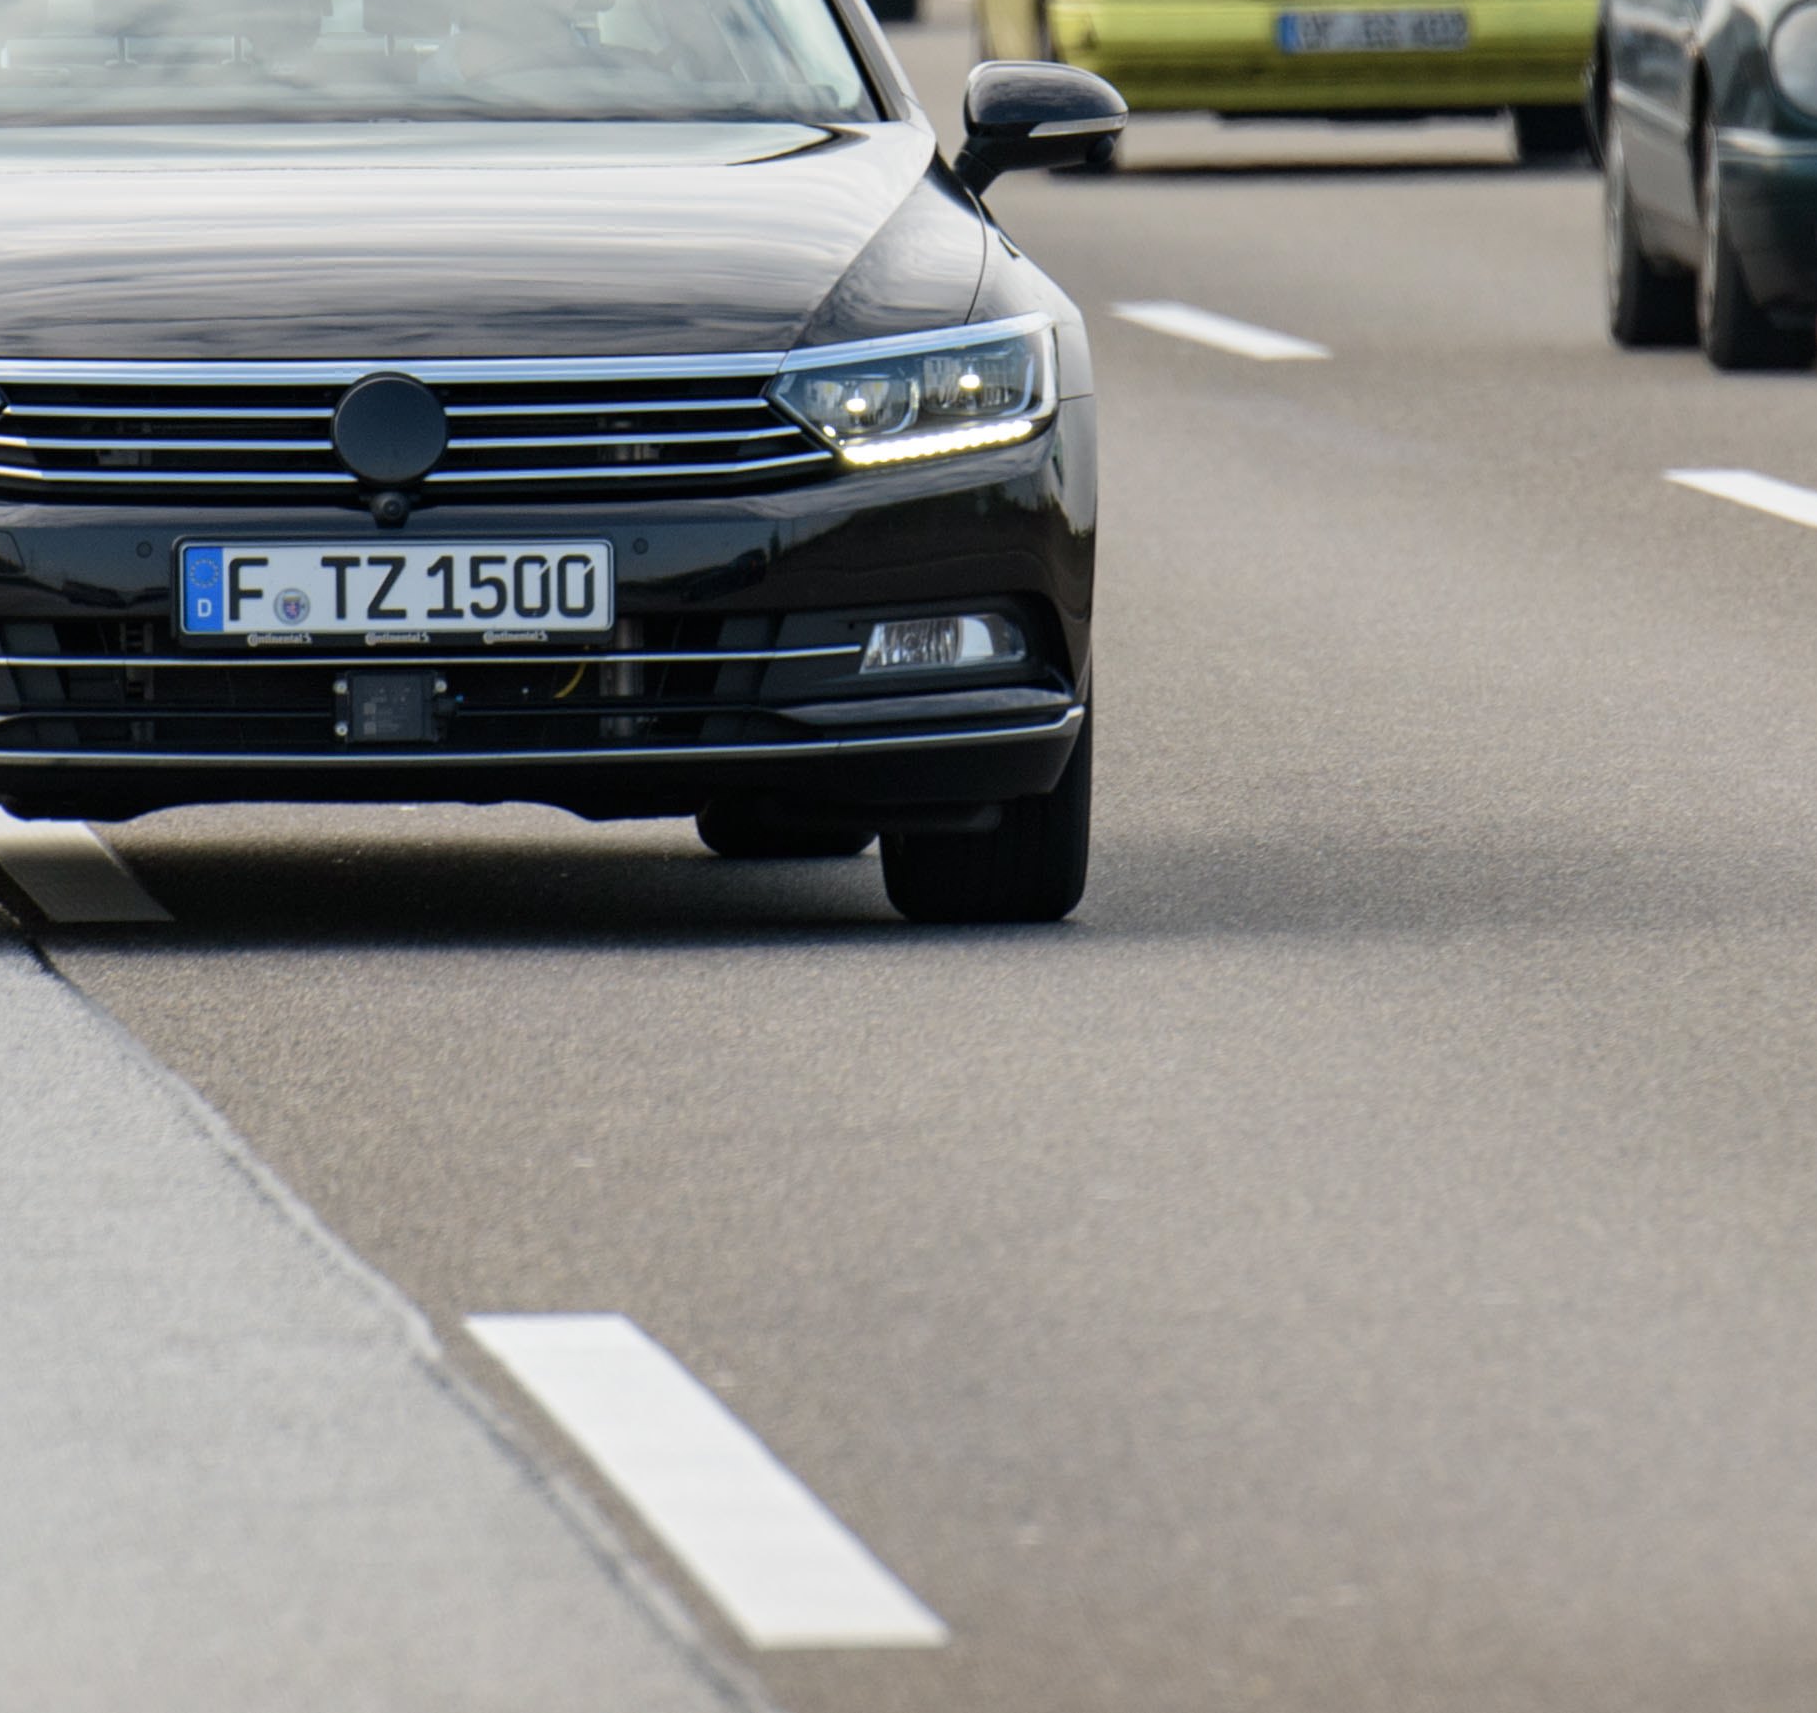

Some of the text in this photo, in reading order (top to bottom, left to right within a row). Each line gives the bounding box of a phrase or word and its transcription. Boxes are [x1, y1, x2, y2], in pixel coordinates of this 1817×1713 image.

[196, 598, 213, 618] D
[228, 553, 595, 621] F TZ 1500
